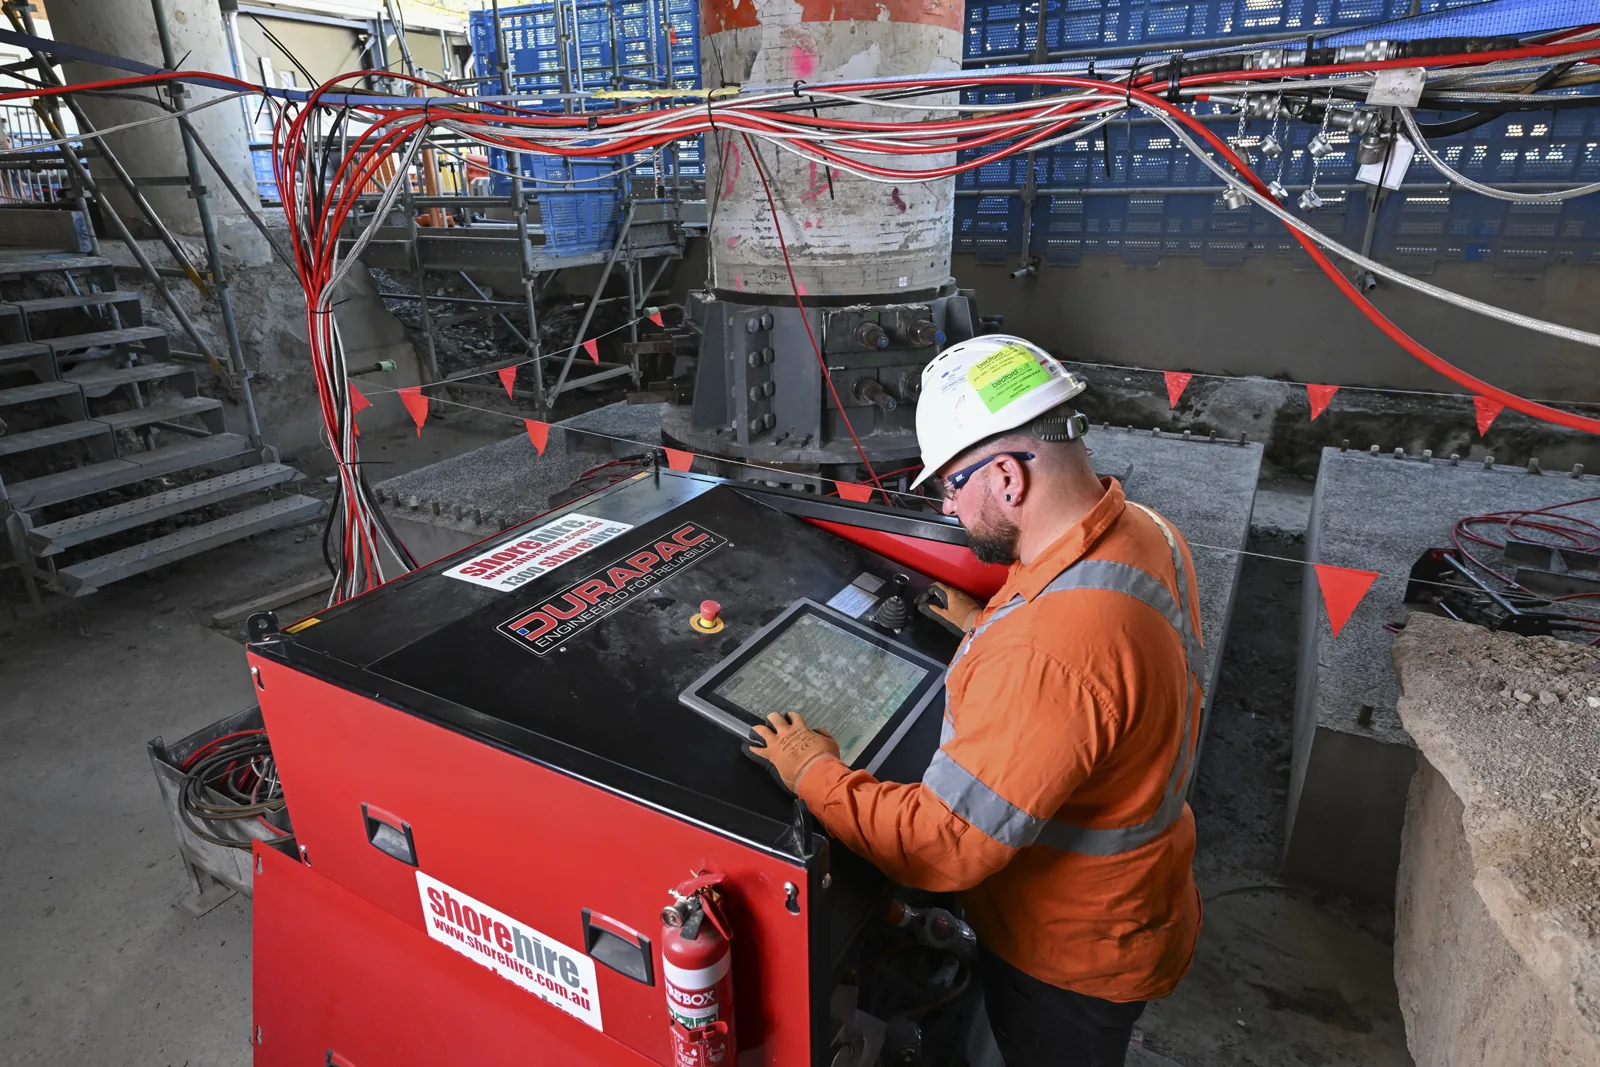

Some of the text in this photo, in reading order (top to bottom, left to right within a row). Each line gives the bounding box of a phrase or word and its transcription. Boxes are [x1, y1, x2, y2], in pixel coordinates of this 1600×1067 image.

[459, 517, 594, 578] shorehire.
[480, 521, 604, 580] www.shorehire.com.au
[500, 526, 627, 587] 1300 shorehire.
[509, 525, 709, 641] DURAPAC
[535, 536, 717, 648] ENGINEERED FOR RELIABILITY
[427, 886, 589, 996] shorehire.
[432, 915, 591, 1012] www.shorehire.com.au
[666, 981, 715, 1007] REBOX
